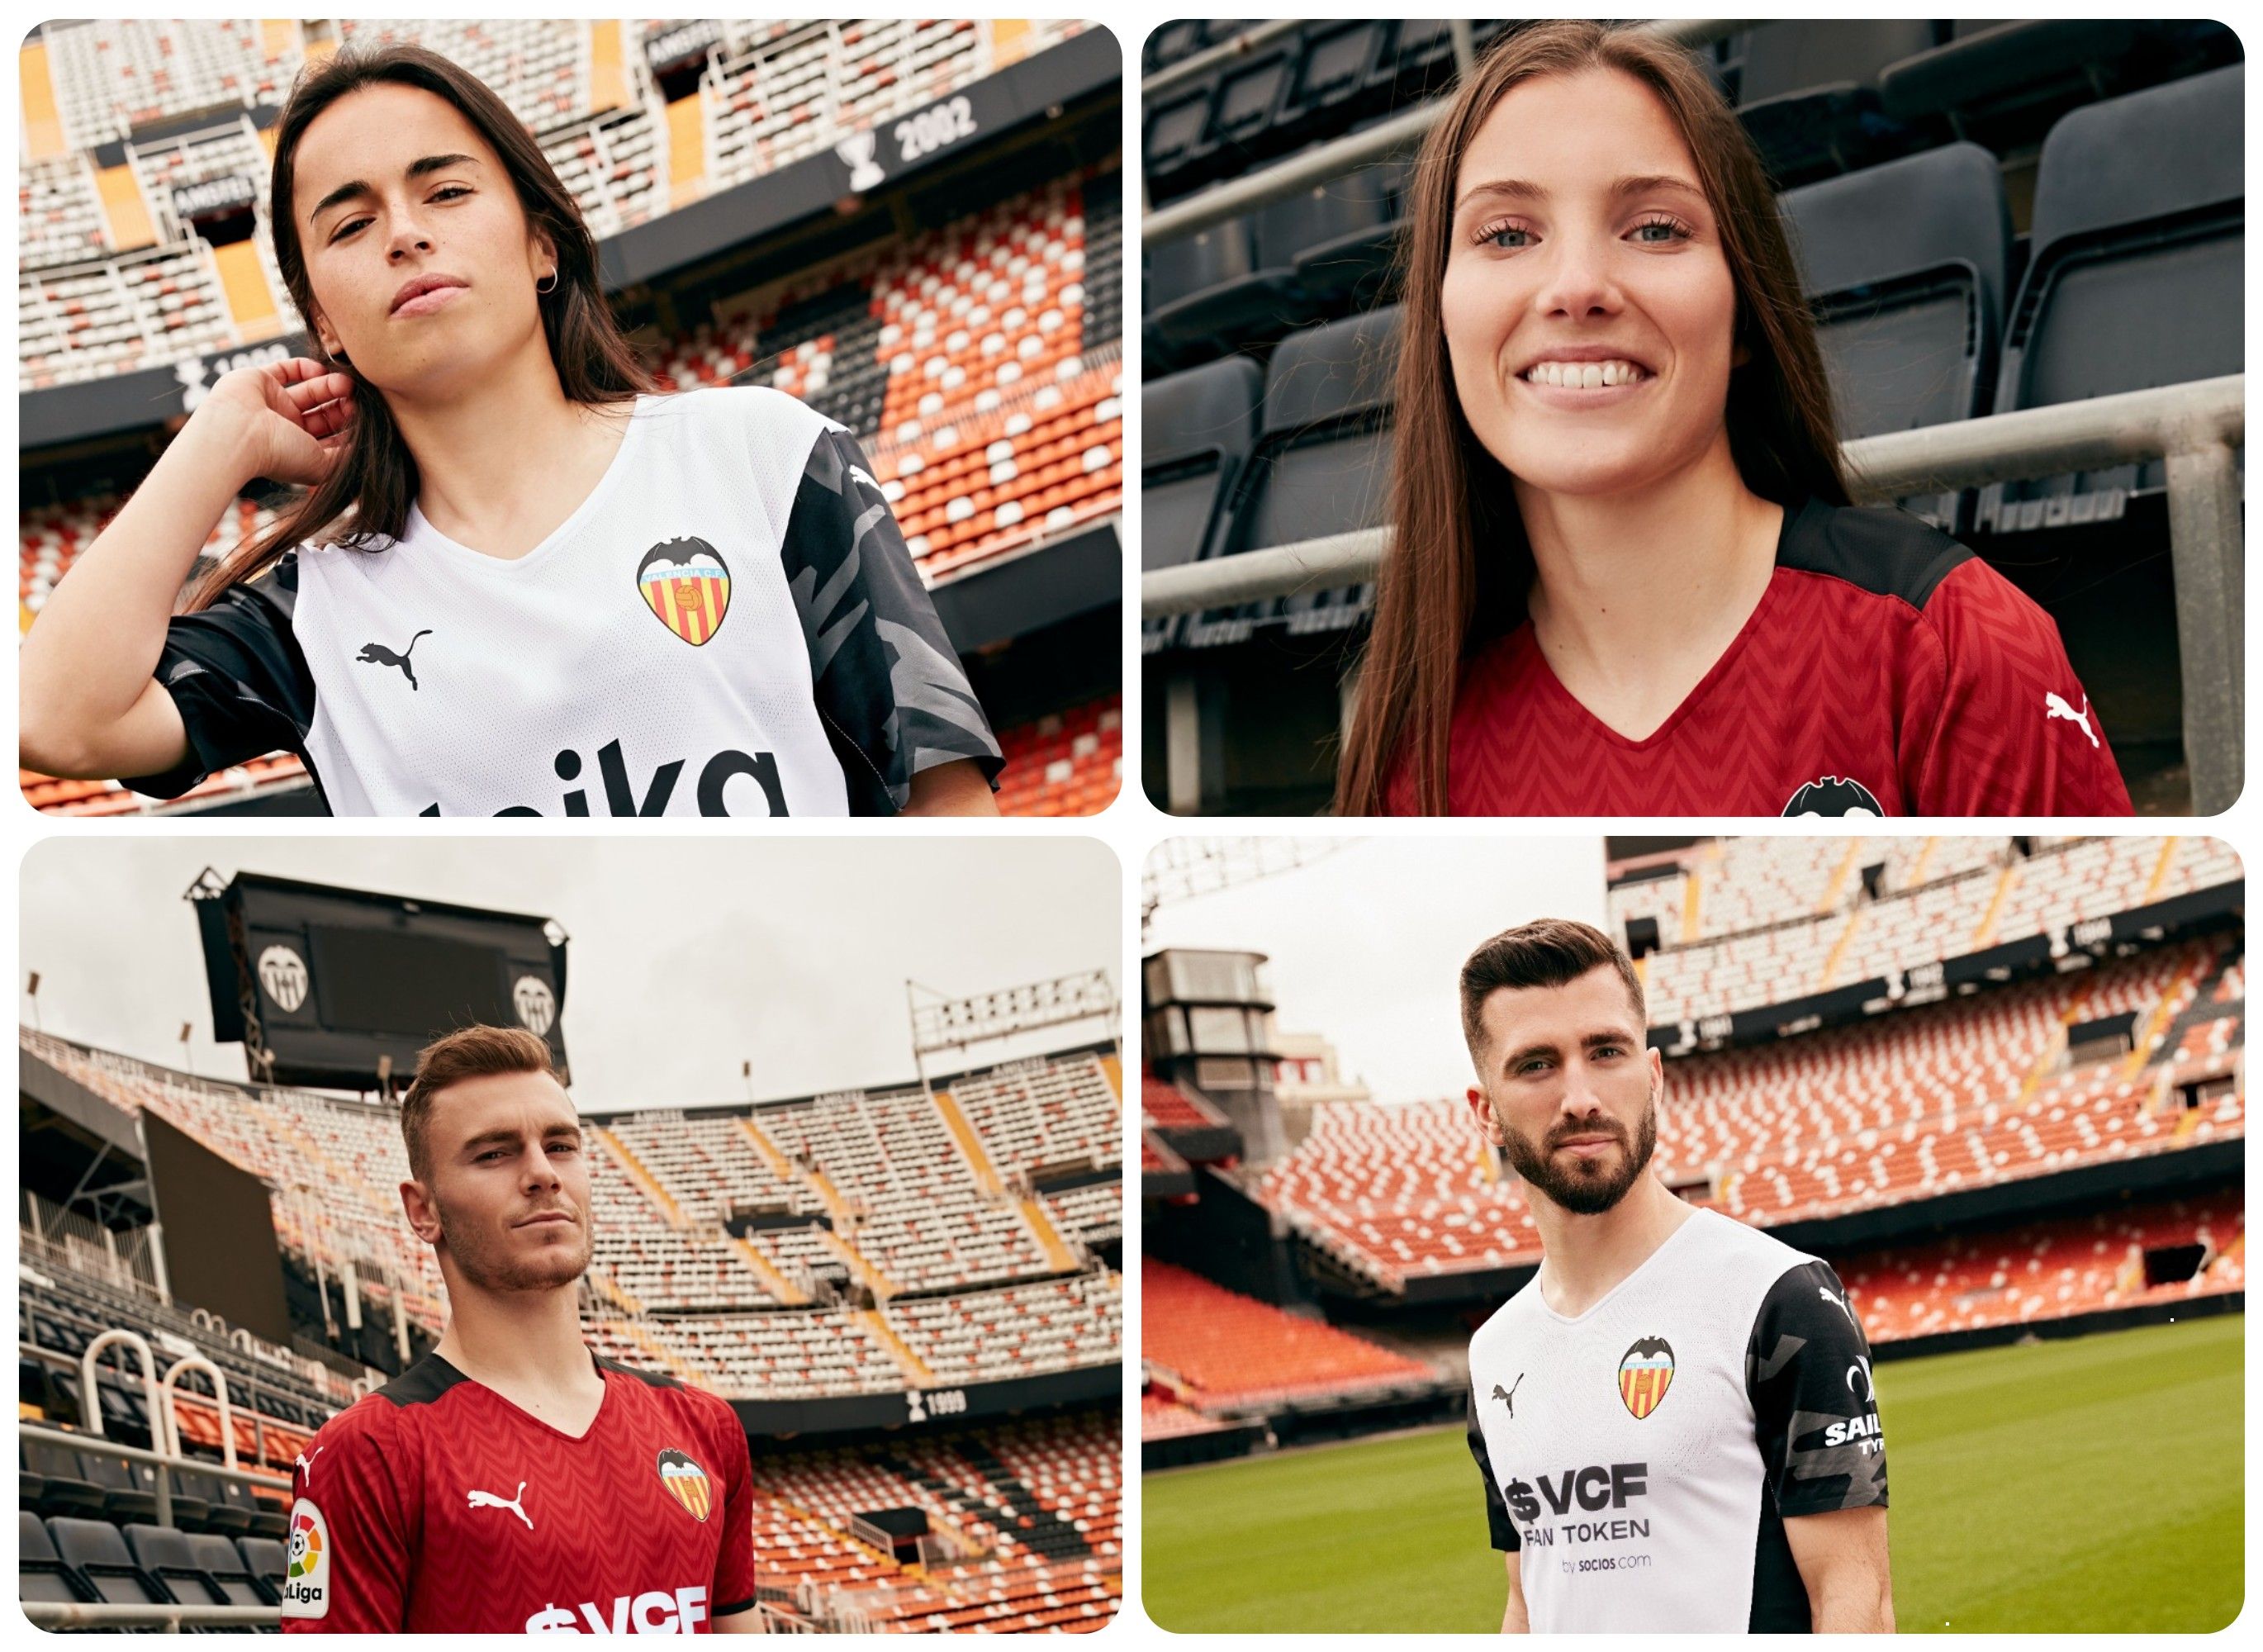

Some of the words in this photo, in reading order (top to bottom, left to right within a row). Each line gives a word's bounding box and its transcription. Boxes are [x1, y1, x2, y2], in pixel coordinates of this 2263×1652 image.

[894, 96, 977, 161] 2002
[419, 738, 790, 816] ika
[1504, 1463, 1648, 1525] $VCF
[1523, 1528, 1554, 1547] FAN
[1562, 1519, 1650, 1544] TOKEN
[1562, 1559, 1575, 1574] by
